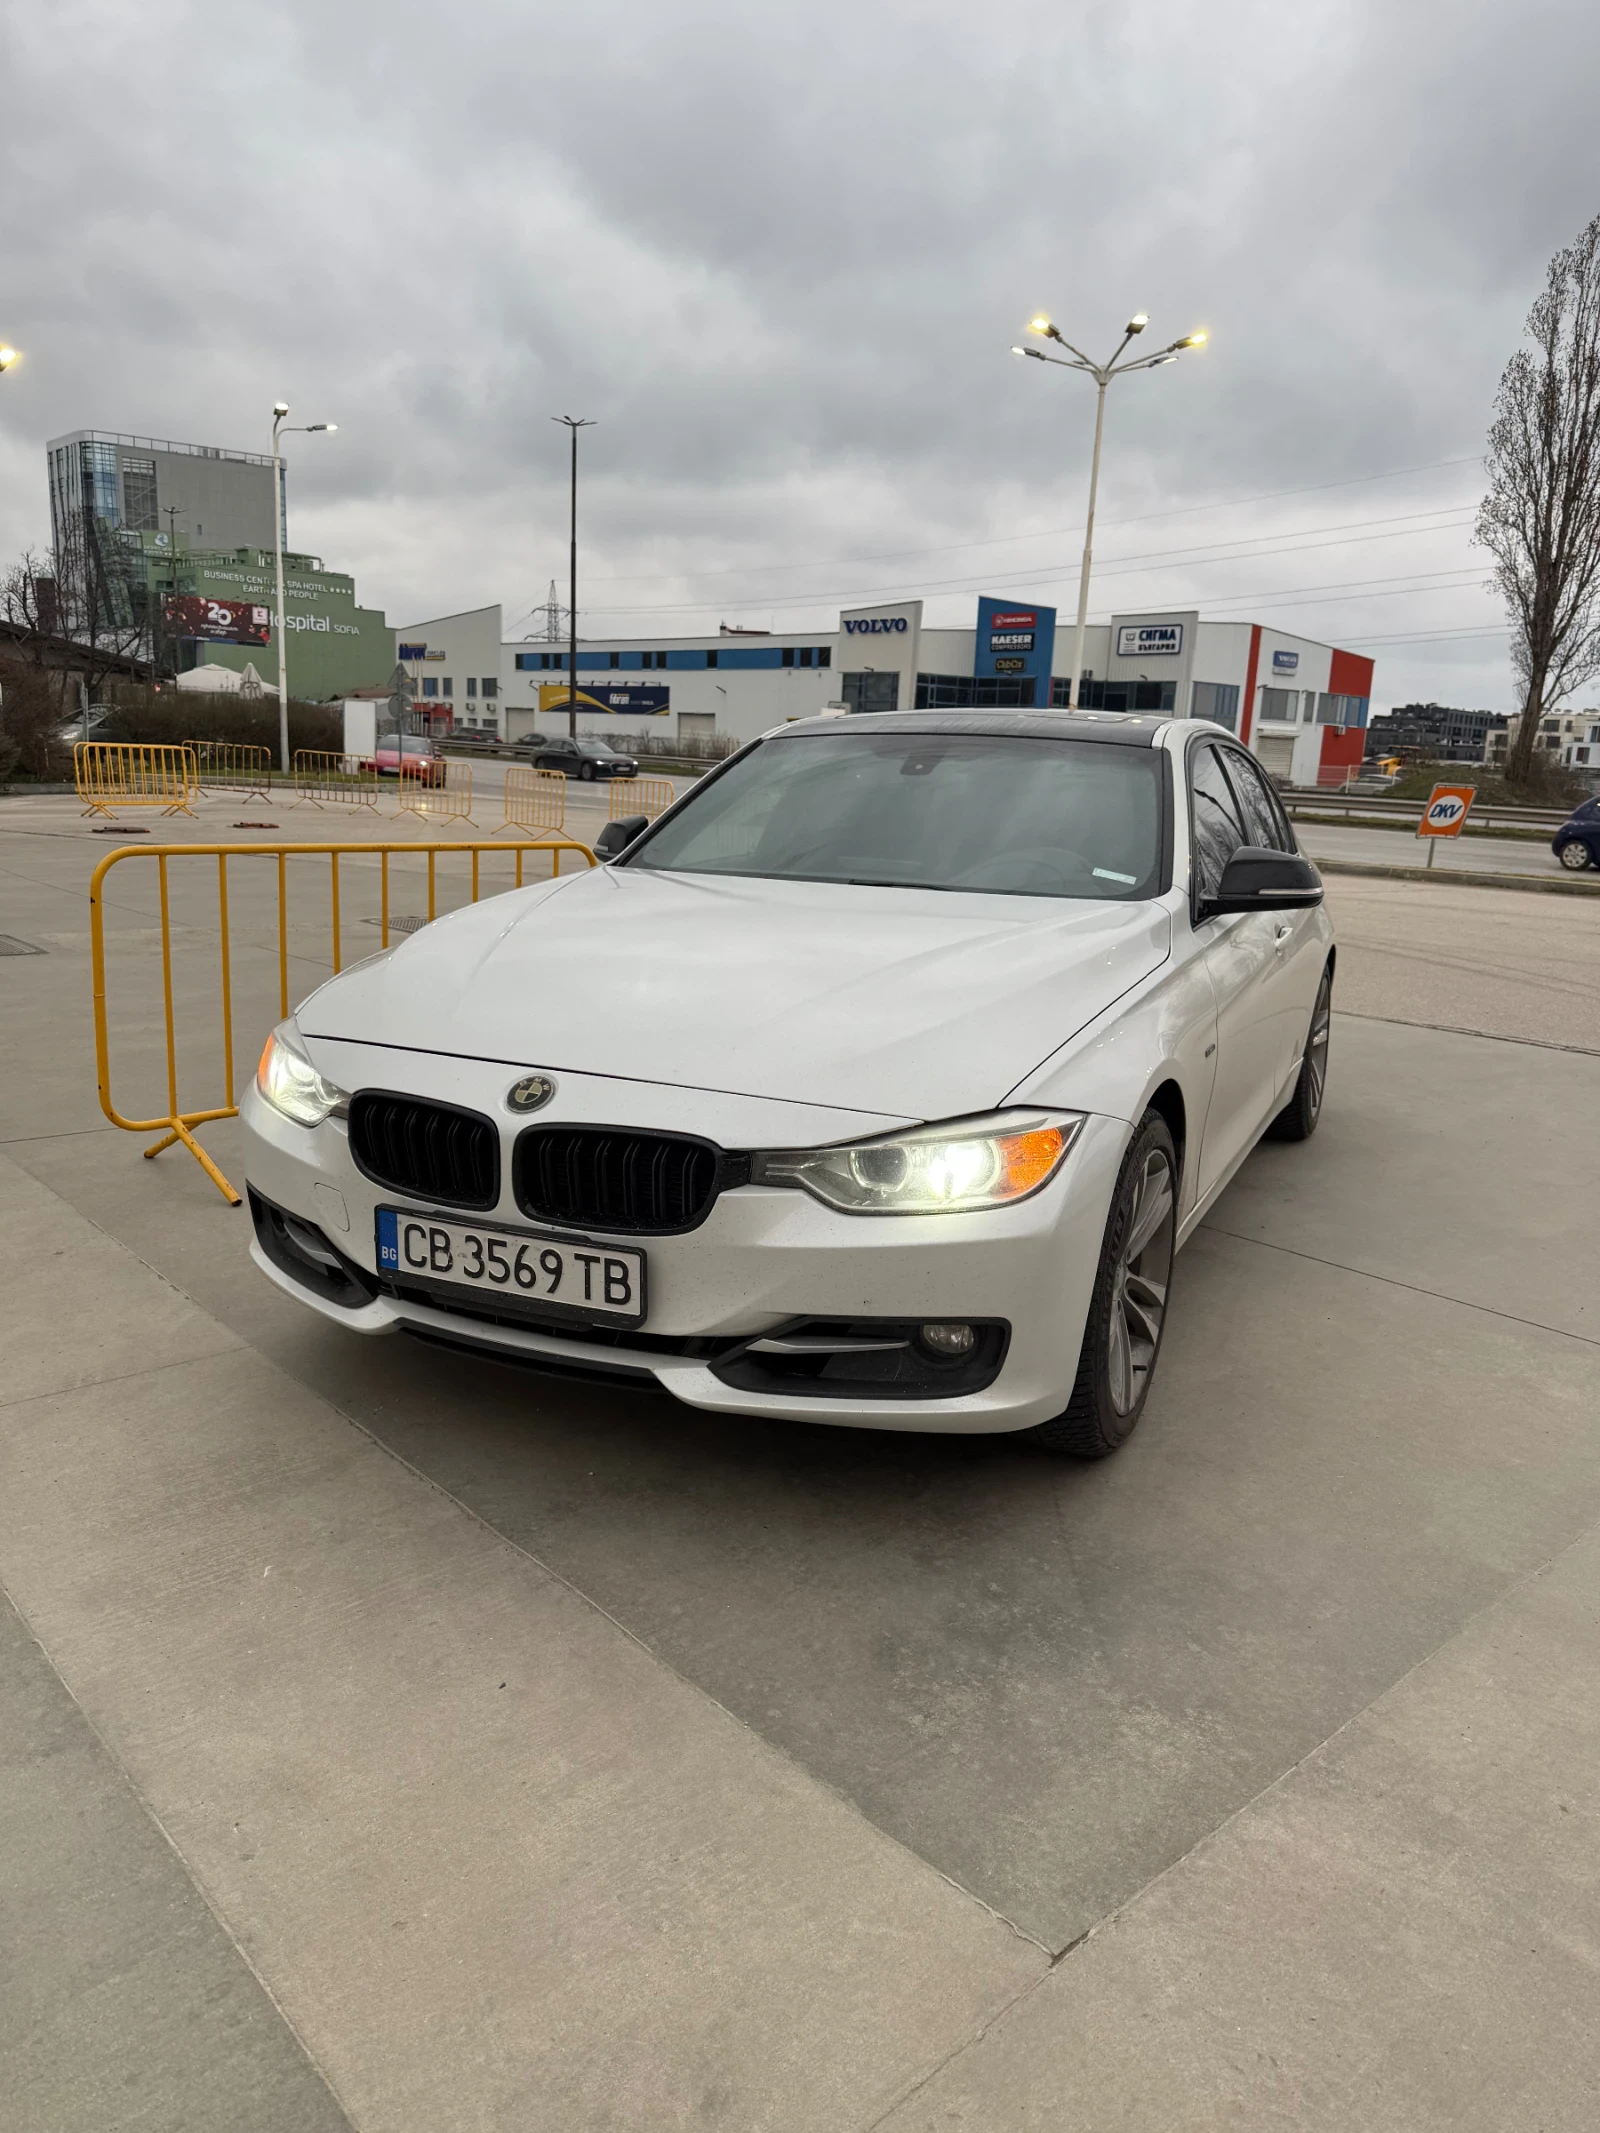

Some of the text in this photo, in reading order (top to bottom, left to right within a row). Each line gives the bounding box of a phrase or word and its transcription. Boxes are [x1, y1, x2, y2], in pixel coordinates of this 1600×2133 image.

[203, 570, 245, 582] BUSINESS
[287, 580, 302, 590] SPA
[303, 582, 328, 593] HOTEL
[243, 584, 319, 600] EARTH AD PEOPLE
[207, 602, 232, 626] 20
[333, 625, 360, 636] SOFIA
[843, 617, 908, 635] VOLVO
[992, 635, 1032, 644] KAESER
[1139, 629, 1176, 641] СИГМА
[1429, 804, 1463, 818] DKV
[381, 1223, 632, 1305] BG CB 3569 TB
